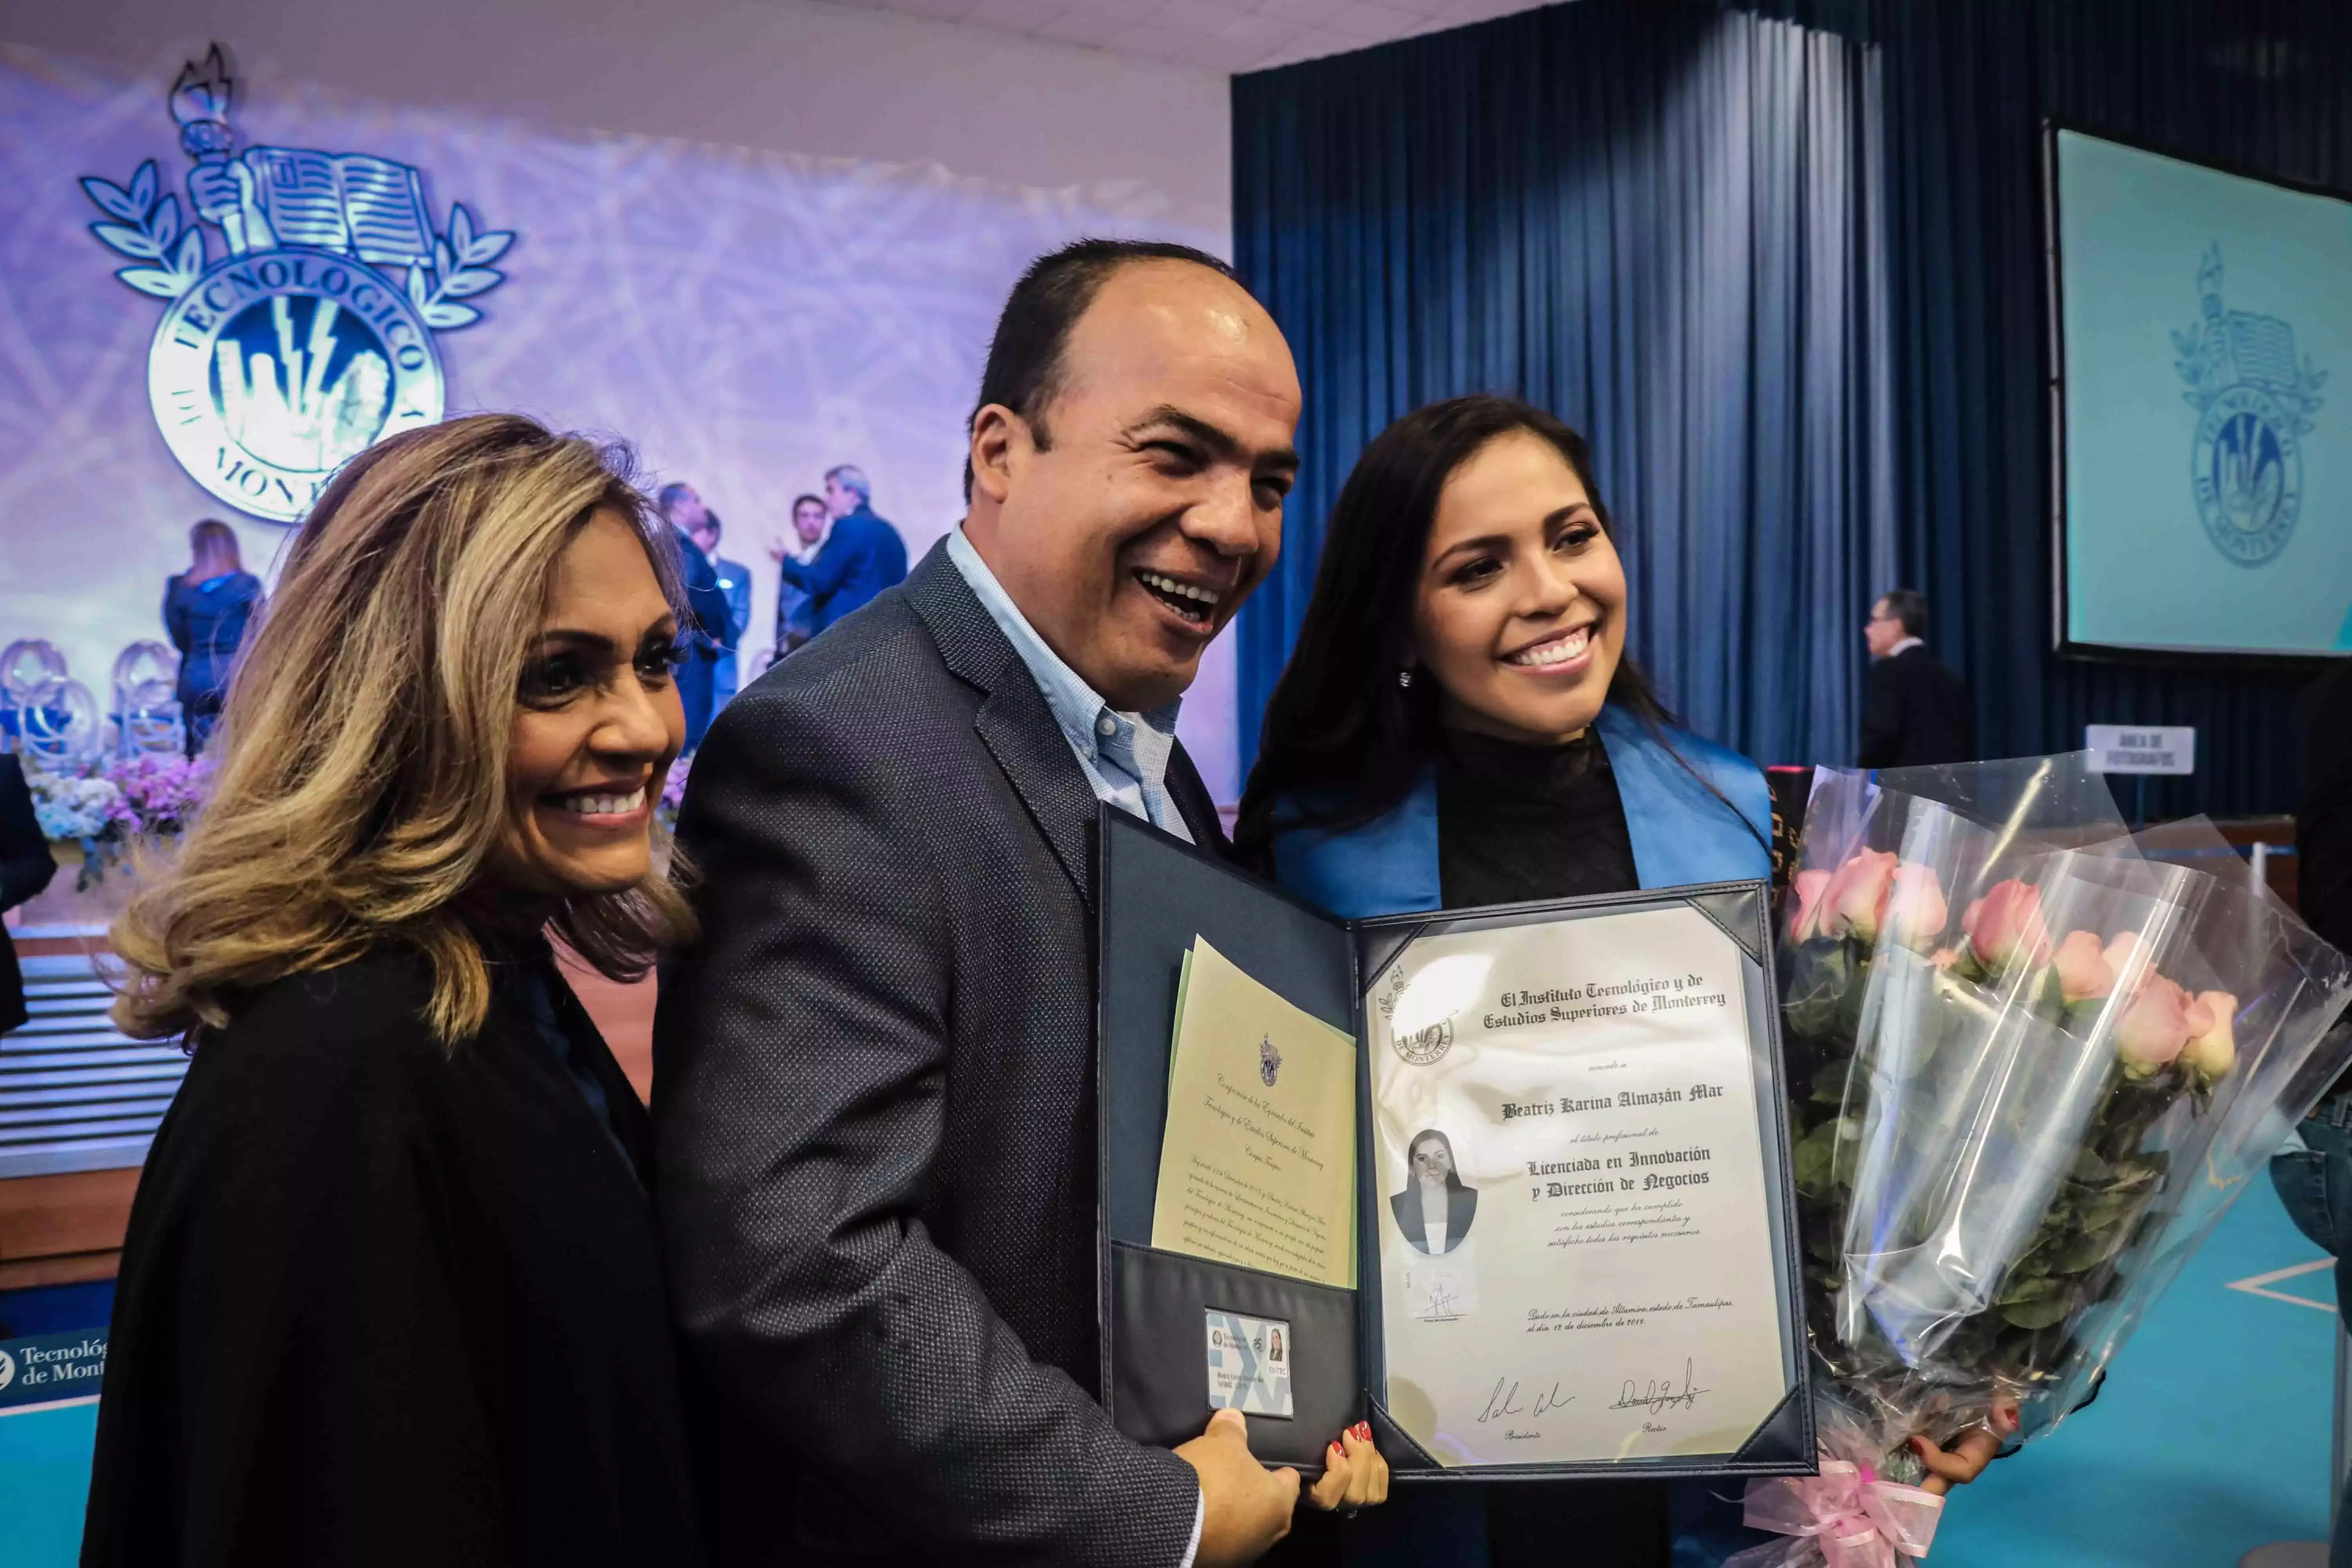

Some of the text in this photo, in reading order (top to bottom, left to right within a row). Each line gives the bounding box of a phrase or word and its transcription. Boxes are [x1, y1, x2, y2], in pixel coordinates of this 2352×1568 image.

[174, 258, 426, 372] TECNOLOGICO
[1501, 974, 1703, 1008] El Instituto Tecnológico y de
[1484, 994, 1726, 1029] Estudios Superiores de Monterrey
[1501, 1084, 1724, 1121] Beatriz Karina Almazán Mar
[1602, 1127, 1648, 1144] profesional
[1649, 1127, 1659, 1136] de
[1527, 1146, 1711, 1176] Licenciada en Innovación
[1532, 1170, 1710, 1202] y Dirección de Negocios
[1560, 1199, 1683, 1217] considerando que ha cumplido
[1570, 1221, 1583, 1230] los
[1585, 1218, 1615, 1229] estudios
[1618, 1214, 1681, 1229] correspondientes
[1681, 1216, 1690, 1227] y
[1586, 1234, 1606, 1243] todos
[1606, 1232, 1620, 1242] los
[1622, 1231, 1658, 1243] requisitos
[1527, 1308, 1549, 1320] Dado
[1561, 1308, 1570, 1318] la
[1571, 1307, 1599, 1318] ciudad
[1599, 1306, 1609, 1316] de
[1647, 1302, 1671, 1312] estado
[1672, 1300, 1683, 1310] de
[1526, 1323, 1535, 1333] el
[1564, 1321, 1574, 1330] de
[1576, 1317, 1613, 1329] diciembre
[1615, 1317, 1625, 1326] de
[22, 1366, 48, 1386] de
[1504, 1429, 1541, 1441] Presidente
[1642, 1421, 1666, 1433] Rector
